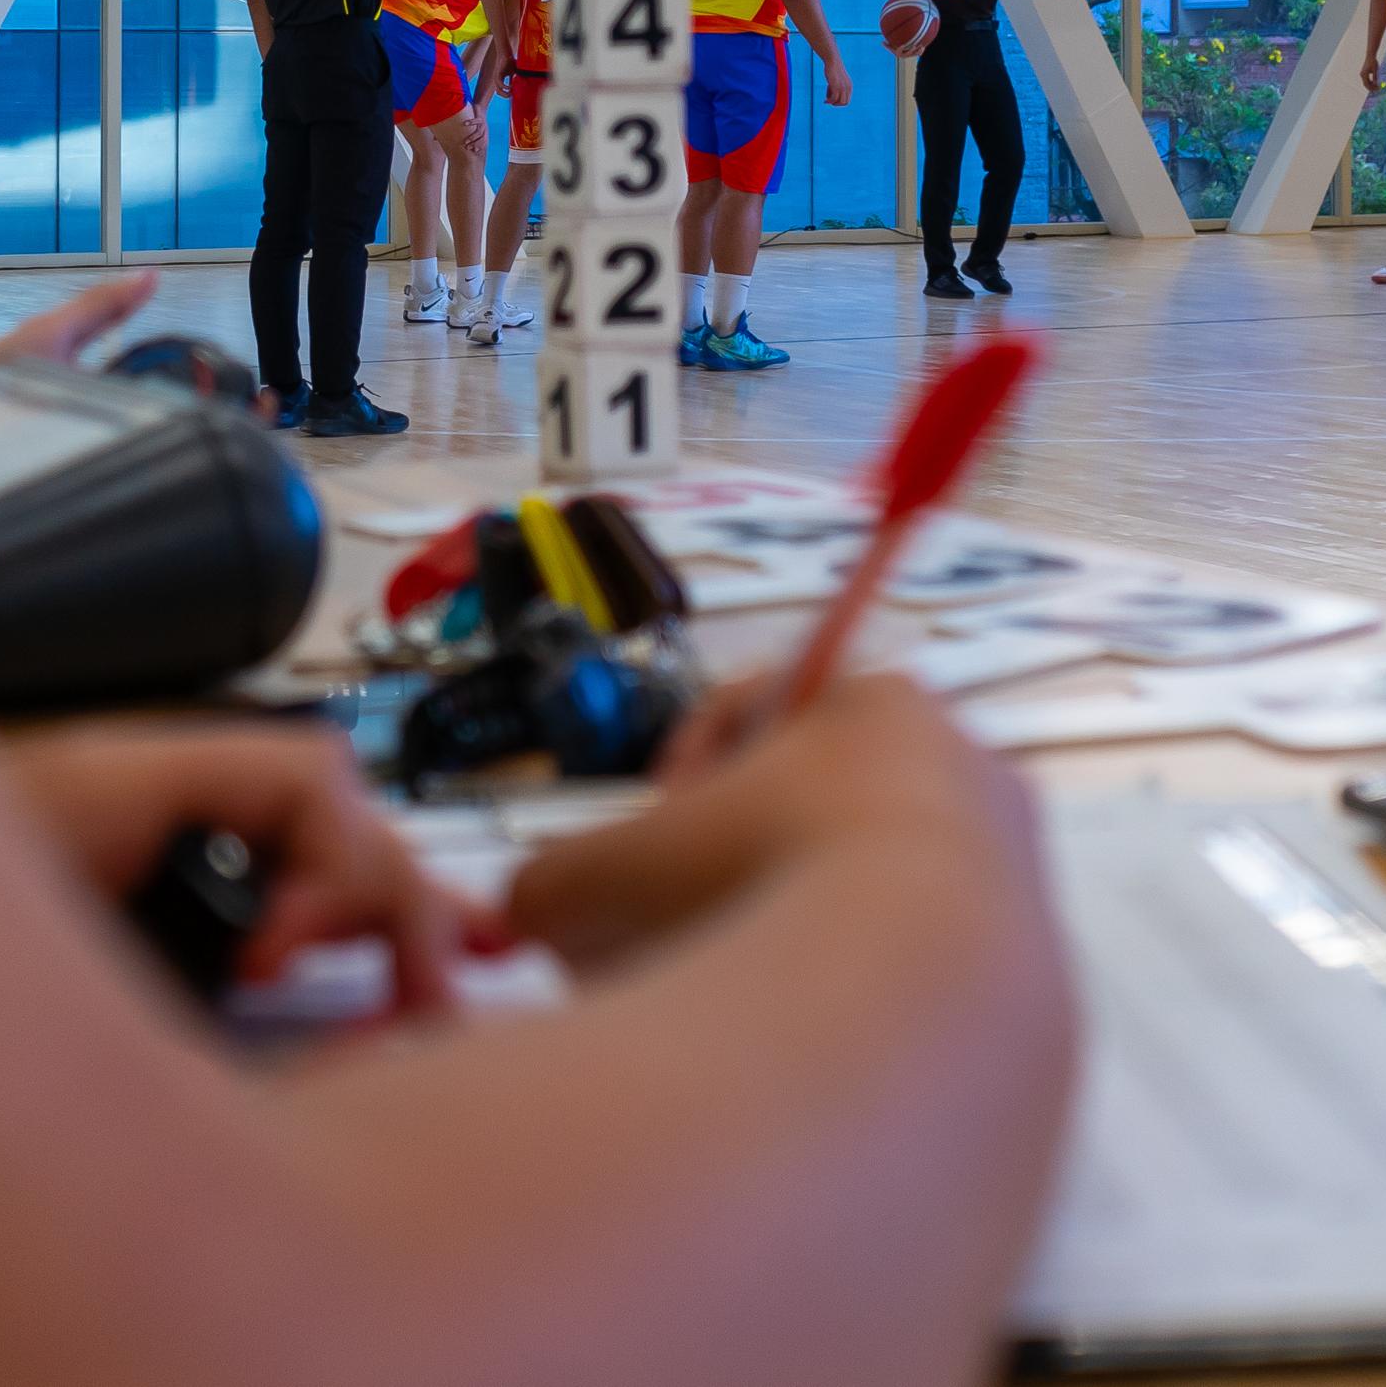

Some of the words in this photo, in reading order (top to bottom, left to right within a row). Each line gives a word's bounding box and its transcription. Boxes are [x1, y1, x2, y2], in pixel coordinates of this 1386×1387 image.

[551, 114, 581, 194] 3
[608, 115, 667, 196] 3
[549, 246, 573, 327] 2
[603, 242, 663, 326] 2
[548, 375, 573, 456] 1
[608, 371, 649, 453] 1
